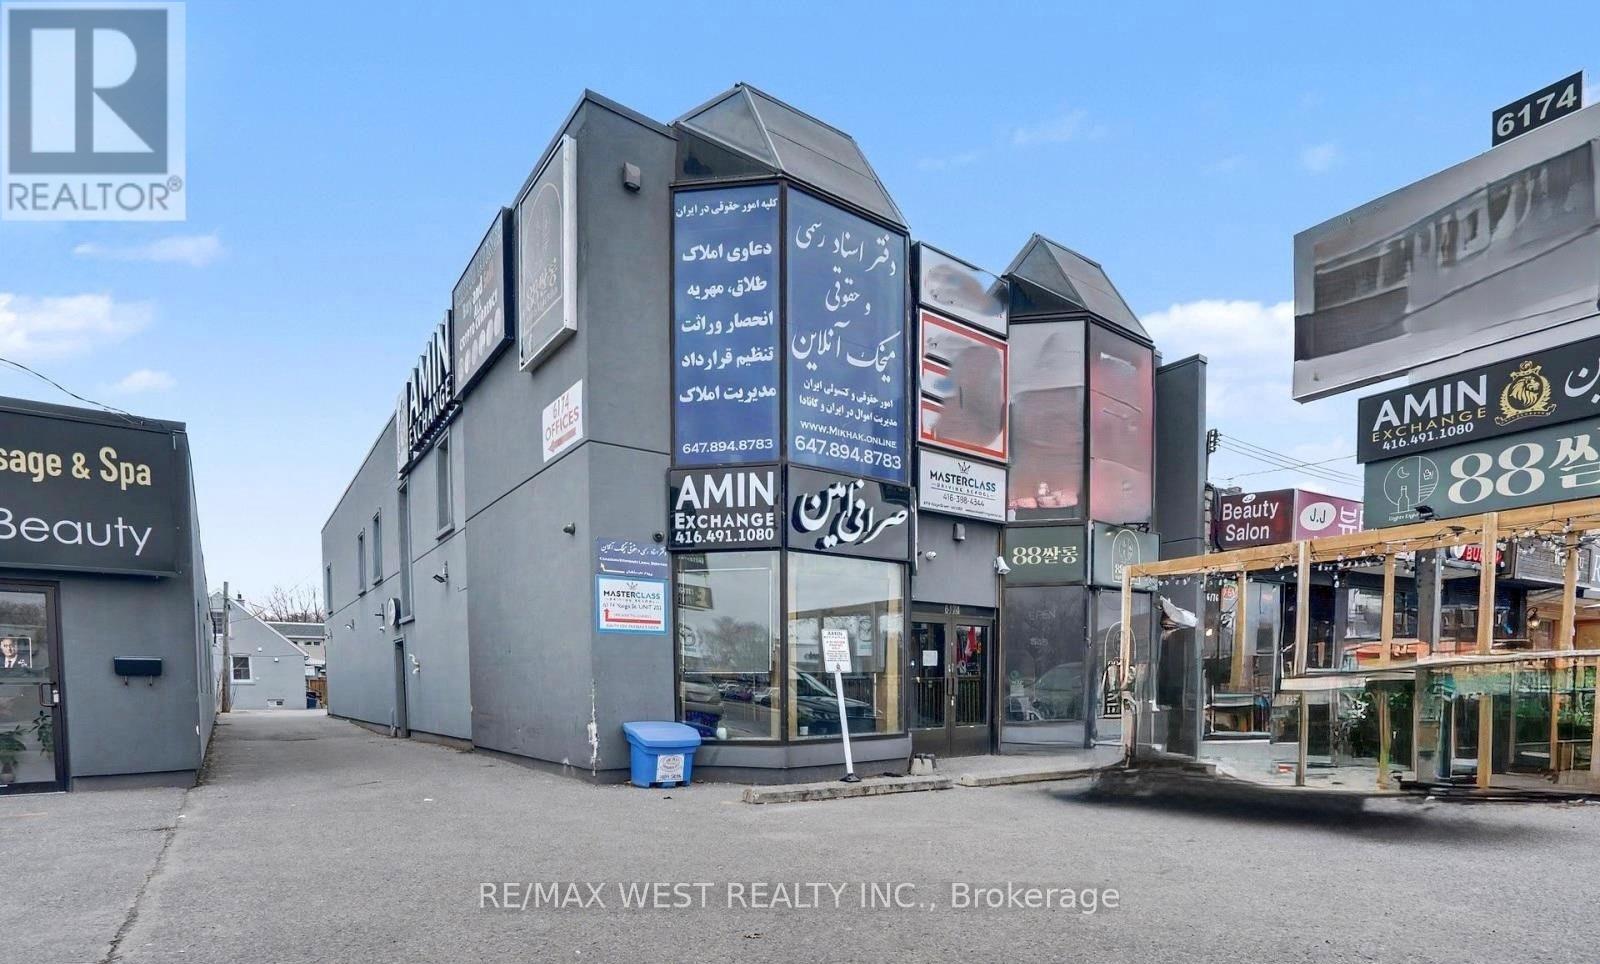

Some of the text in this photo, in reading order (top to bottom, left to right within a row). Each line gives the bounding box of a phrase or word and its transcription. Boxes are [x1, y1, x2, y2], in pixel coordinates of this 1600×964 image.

[1495, 84, 1578, 140] 6174
[676, 198, 778, 218] کلیه امور حقوقی در ایران
[682, 242, 772, 262] دعاوی املاک
[795, 221, 896, 276] دفتر اسناد رسمی
[687, 283, 724, 300] مهریه
[825, 266, 861, 313] حقوقی
[682, 310, 774, 335] انحصار وراثت
[682, 346, 775, 371] تنظیم قرارداد
[792, 320, 902, 383] میخک آنلاین
[679, 383, 777, 403] مدیریت املاک
[1373, 374, 1487, 432] AMIN
[545, 406, 580, 442] OFFICES
[1372, 409, 1487, 443] EXCHANGE
[1382, 422, 1475, 451] 416.491.1080
[682, 439, 774, 455] 647.894.8783
[795, 435, 902, 470] 647.894.8783
[71, 452, 91, 479] &
[100, 447, 152, 491] Spa
[930, 470, 996, 492] MASTERCLASS
[676, 471, 774, 509] AMIN
[675, 512, 775, 533] EXCHANGE
[1222, 500, 1280, 522] Beauty
[1309, 508, 1327, 524] J.J
[0, 507, 153, 557] Beauty
[676, 529, 774, 544] 416.491.1080
[1225, 522, 1270, 542] Salon
[1012, 545, 1080, 565] 88쌀롱
[603, 590, 661, 600] MASTERCLASS
